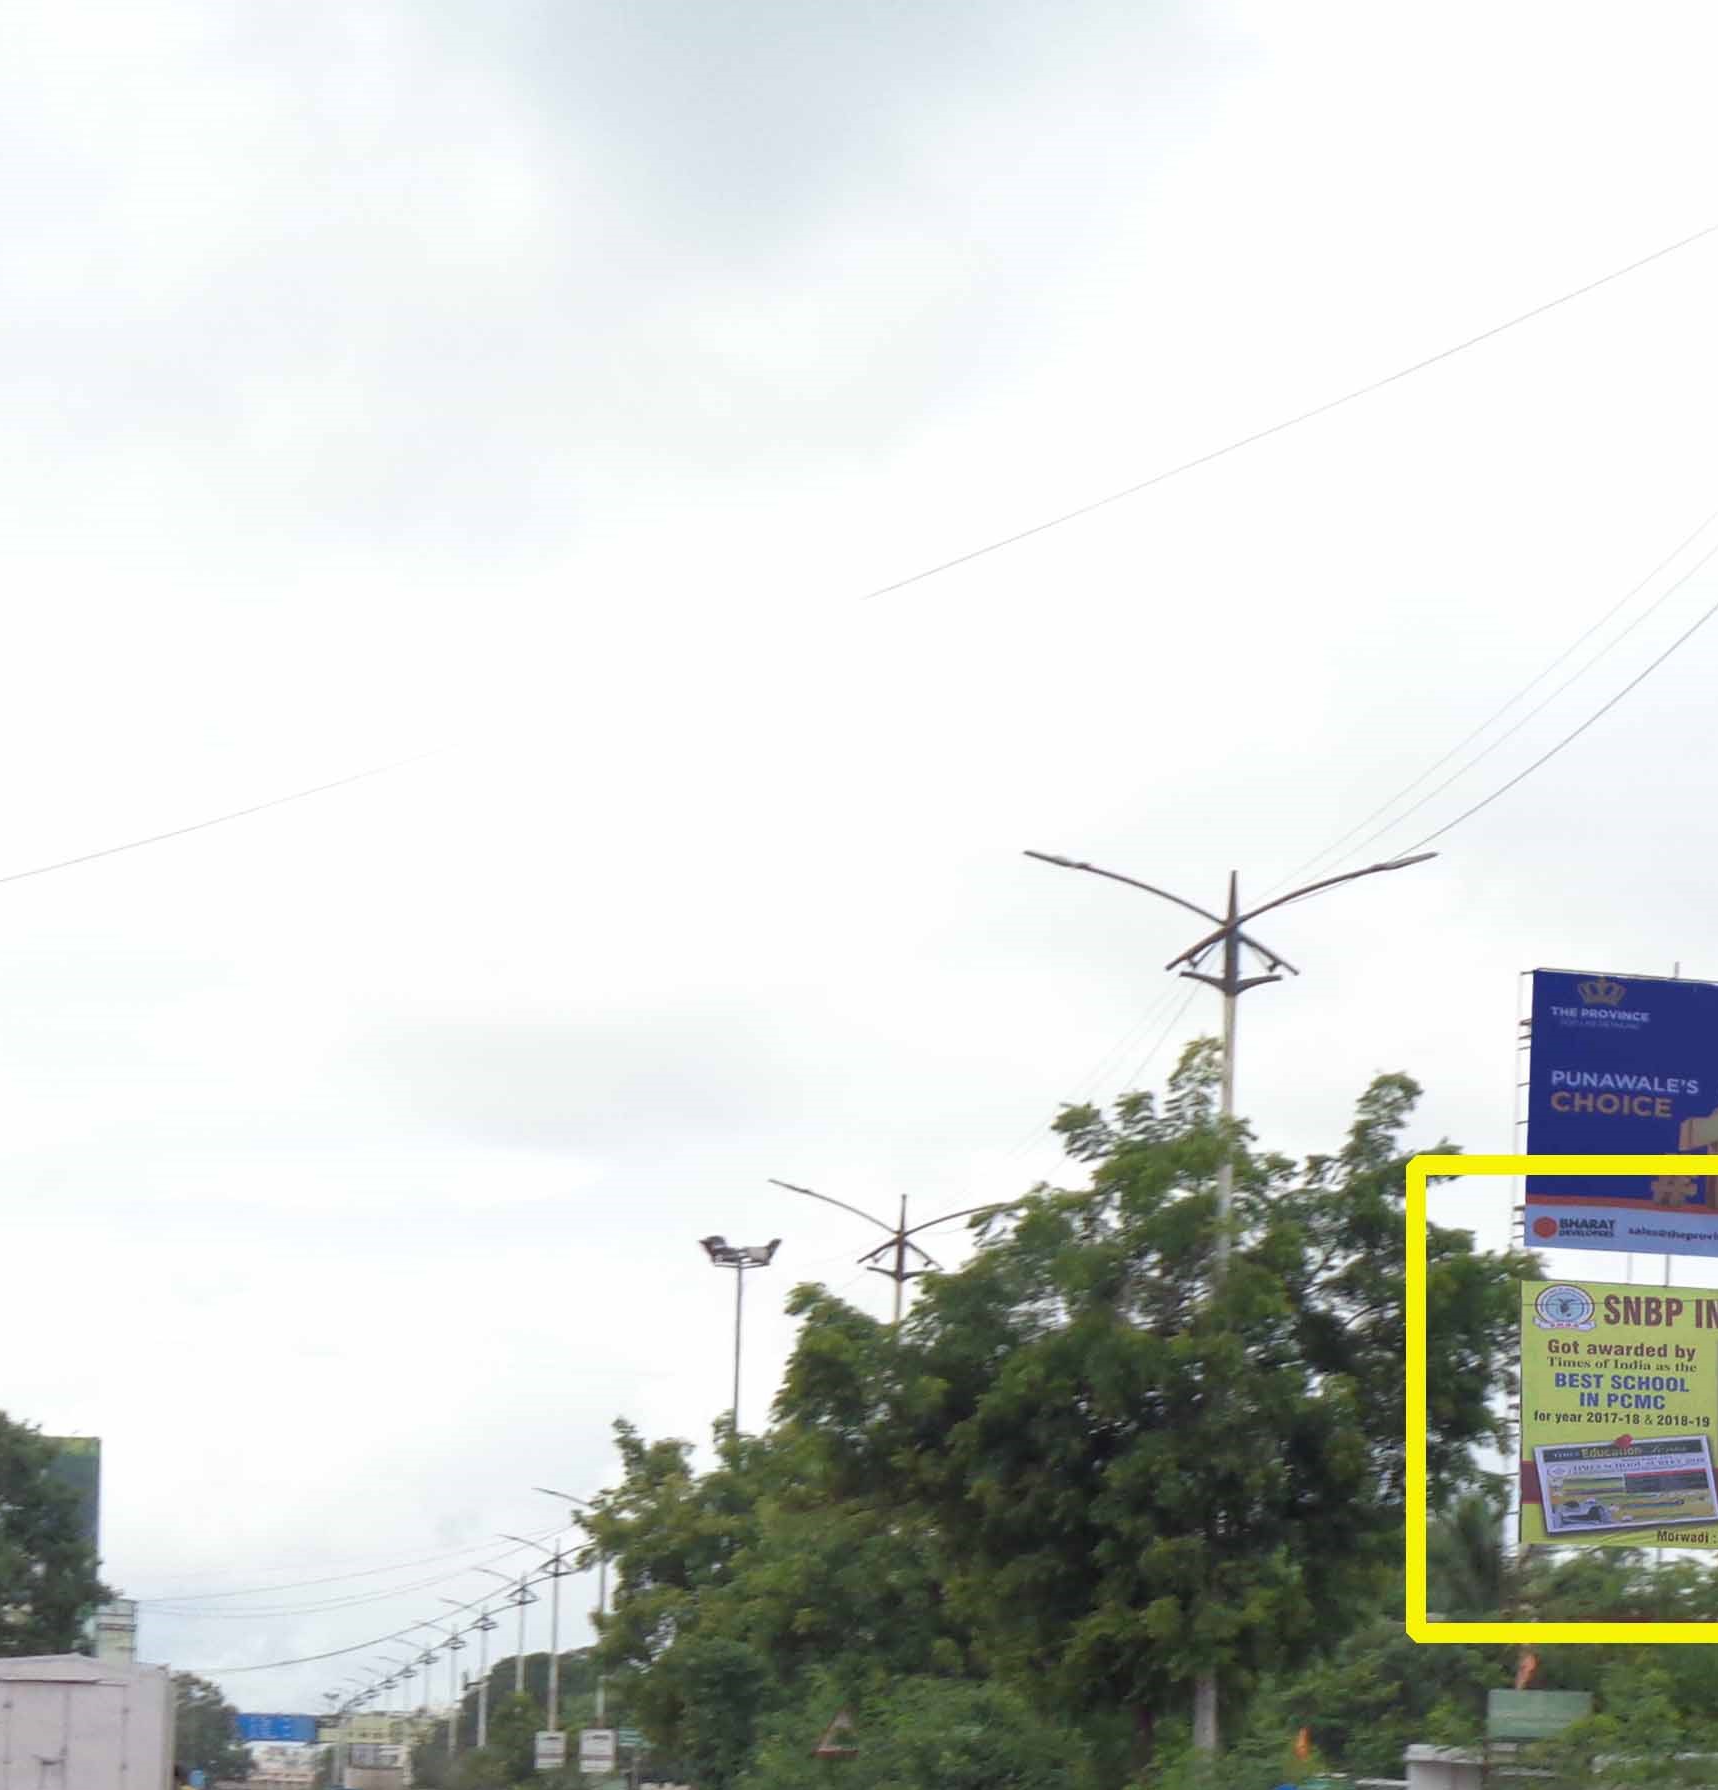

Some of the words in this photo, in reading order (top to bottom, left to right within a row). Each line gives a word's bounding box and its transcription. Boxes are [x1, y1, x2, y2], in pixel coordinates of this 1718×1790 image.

[1551, 1006, 1577, 1018] THE
[1581, 1008, 1650, 1022] PROVINCE
[1551, 1070, 1699, 1095] PUNAWALE'S
[1550, 1091, 1672, 1118] CHOICE
[1559, 1218, 1616, 1231] BHARAT
[1603, 1294, 1683, 1326] SNBP
[1547, 1339, 1581, 1354] Got
[1587, 1342, 1668, 1359] awarded
[1674, 1345, 1696, 1362] by
[1547, 1356, 1591, 1368] Times
[1595, 1357, 1609, 1369] of
[1613, 1359, 1651, 1371] India
[1655, 1363, 1671, 1372] as
[1675, 1362, 1697, 1373] the
[1555, 1373, 1603, 1388] BEST
[1611, 1375, 1689, 1392] SCHOOL
[1579, 1393, 1598, 1407] IN
[1607, 1394, 1666, 1410] PCMC
[1534, 1411, 1551, 1422] for
[1555, 1413, 1582, 1425] year
[1587, 1412, 1640, 1425] 2017-18
[1645, 1414, 1654, 1425] &
[1657, 1413, 1710, 1427] 2018-19
[1657, 1530, 1709, 1544] Morwadi
